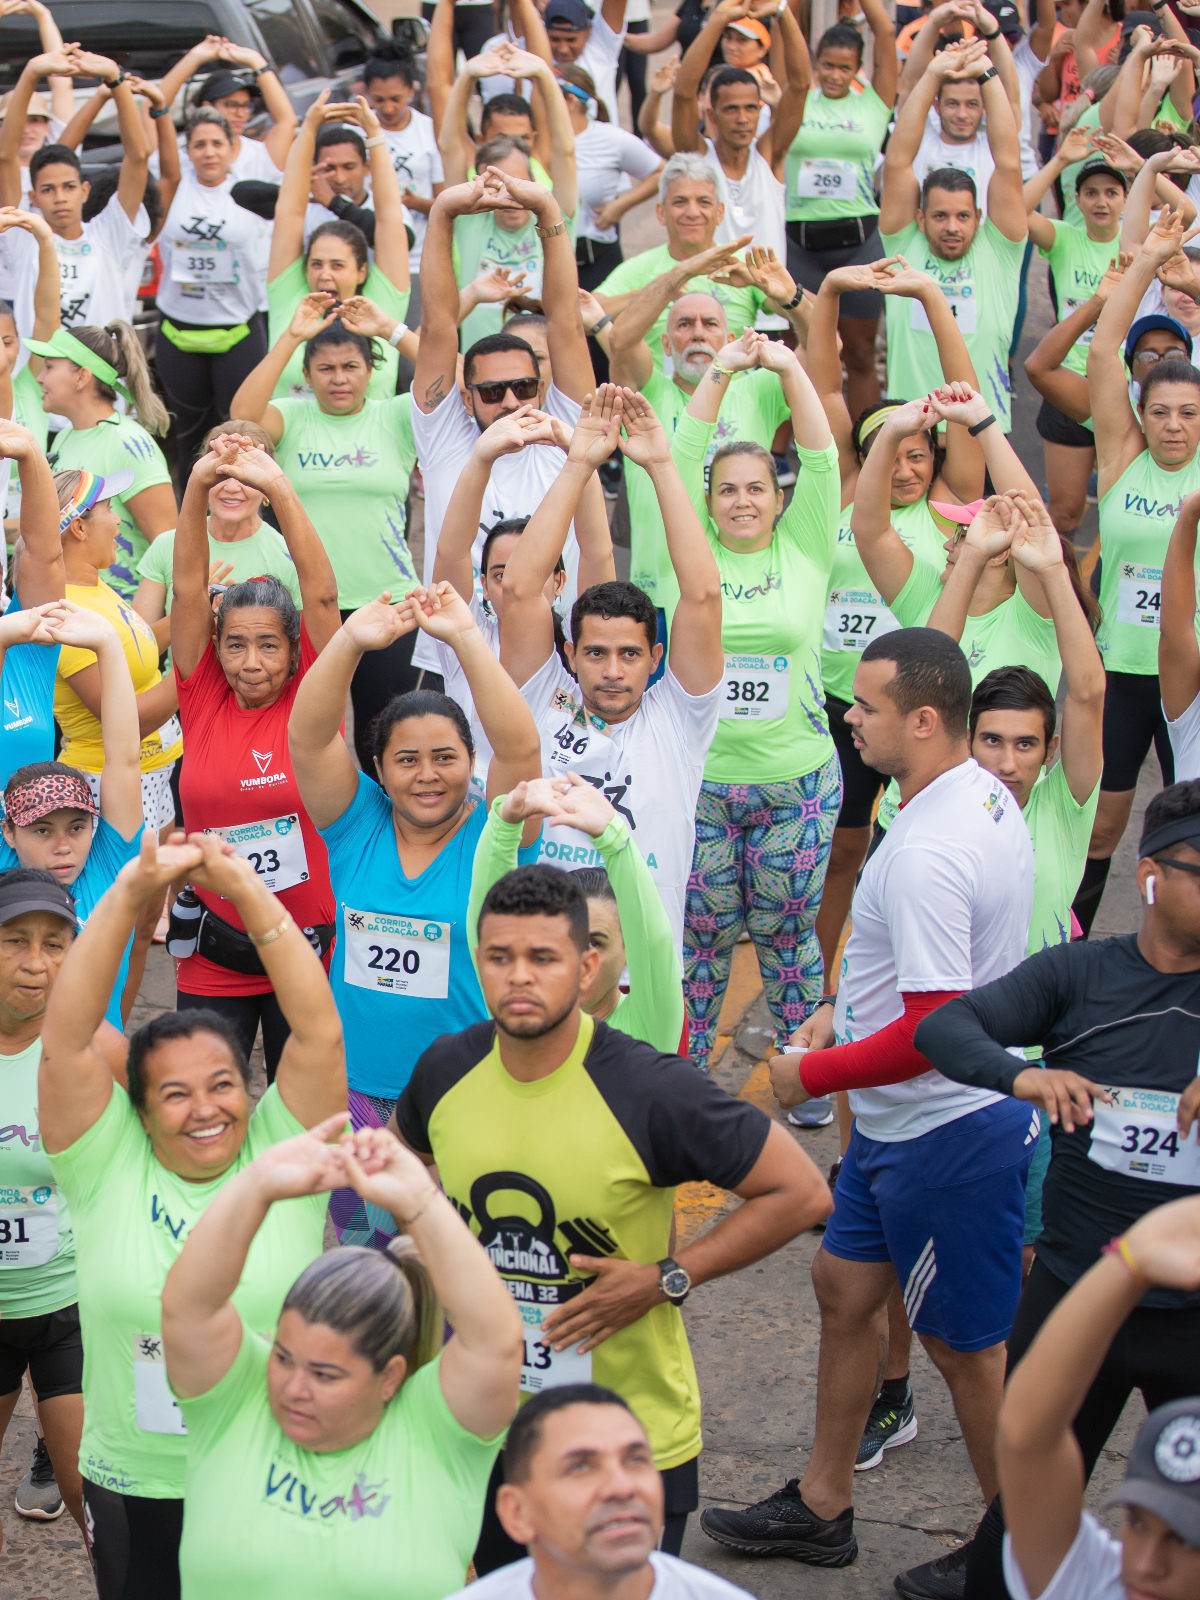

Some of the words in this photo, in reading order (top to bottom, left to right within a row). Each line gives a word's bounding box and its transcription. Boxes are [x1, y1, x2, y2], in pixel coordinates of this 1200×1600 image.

[813, 174, 842, 188] 269
[187, 256, 216, 271] 335
[838, 614, 877, 635] 327
[731, 656, 765, 664] CORRIDA
[726, 680, 770, 702] 382
[554, 723, 589, 756] 486
[240, 772, 287, 788] VUMBORA
[226, 836, 237, 844] DA
[238, 830, 273, 844] DOAÇÃO
[229, 824, 265, 837] CORRIDA
[367, 923, 380, 932] DA
[382, 925, 419, 937] DOAÇÃO
[374, 916, 413, 929] CORRIDA
[367, 944, 420, 975] 220
[1132, 1091, 1177, 1105] CORRIDA
[1123, 1099, 1137, 1107] DA
[1140, 1101, 1177, 1113] DOAÇÃ
[1120, 1125, 1179, 1158] 324
[489, 1246, 560, 1275] UNCIONAL
[538, 1286, 559, 1302] 32
